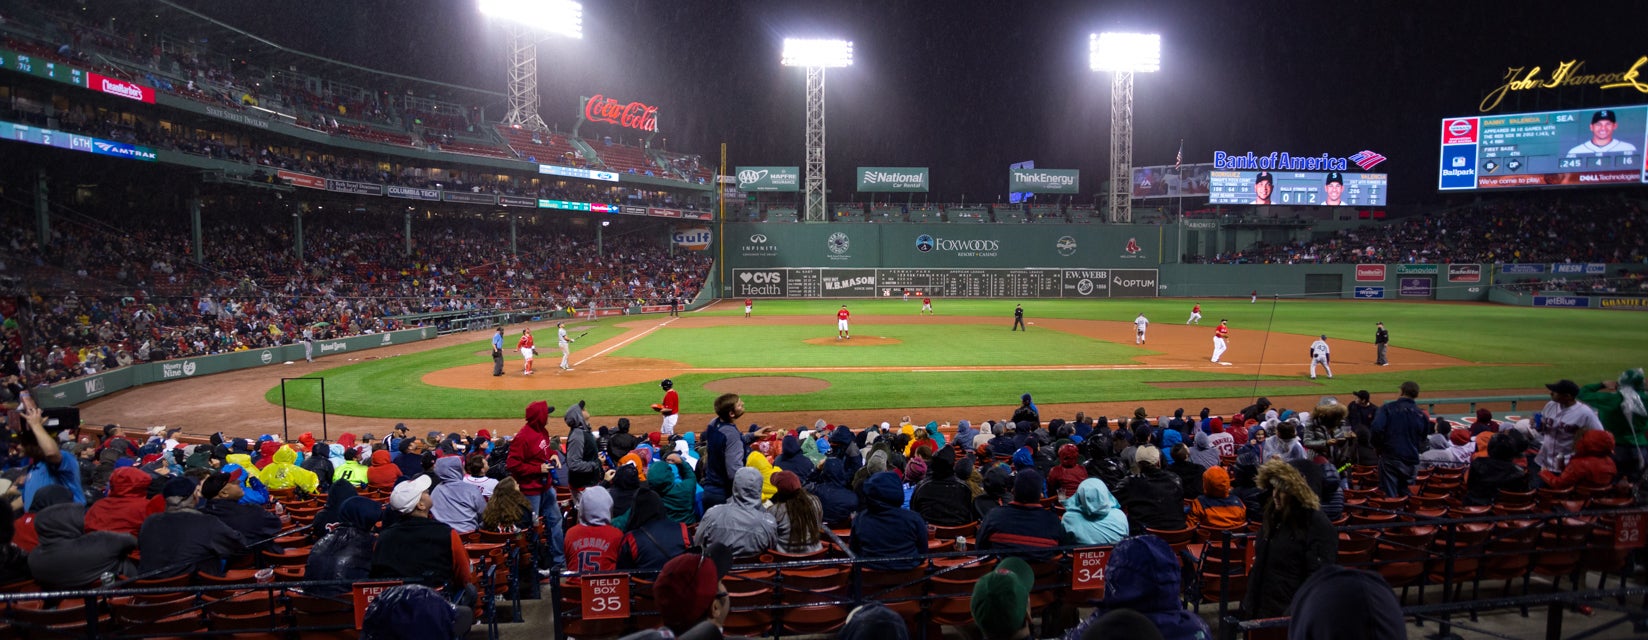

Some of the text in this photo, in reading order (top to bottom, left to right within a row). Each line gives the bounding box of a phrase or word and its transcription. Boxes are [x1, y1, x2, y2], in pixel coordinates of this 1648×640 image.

[1479, 55, 1648, 112] John Hancock
[1556, 114, 1574, 122] SEA
[44, 134, 50, 144] 2
[73, 138, 91, 149] 6TH
[112, 147, 156, 160] AMTRAK
[1214, 150, 1347, 171] Bank of America
[1560, 160, 1581, 168] .245
[1623, 157, 1632, 165] 16
[739, 171, 759, 184] AAA
[877, 172, 923, 183] National
[1443, 168, 1474, 177] Ballpark
[389, 187, 438, 198] COLUMBIA TECH
[1283, 193, 1289, 203] 0
[1309, 193, 1316, 203] 2
[673, 231, 711, 243] Gulf
[1558, 264, 1583, 273] NESN
[753, 271, 781, 284] CVS
[1081, 271, 1107, 279] WEBB
[1123, 279, 1155, 288] OPTUM
[741, 284, 781, 295] Health
[1545, 296, 1576, 306] jetBlue
[1602, 298, 1639, 307] GRANITE
[164, 369, 182, 378] Nine
[341, 470, 353, 480] H
[1618, 529, 1639, 542] 32
[1080, 551, 1104, 559] FIELD
[577, 551, 602, 573] 15
[1082, 558, 1101, 566] BOX
[1077, 567, 1105, 583] 34
[589, 578, 621, 587] FIELD
[594, 586, 616, 595] BOX
[590, 596, 622, 612] 35
